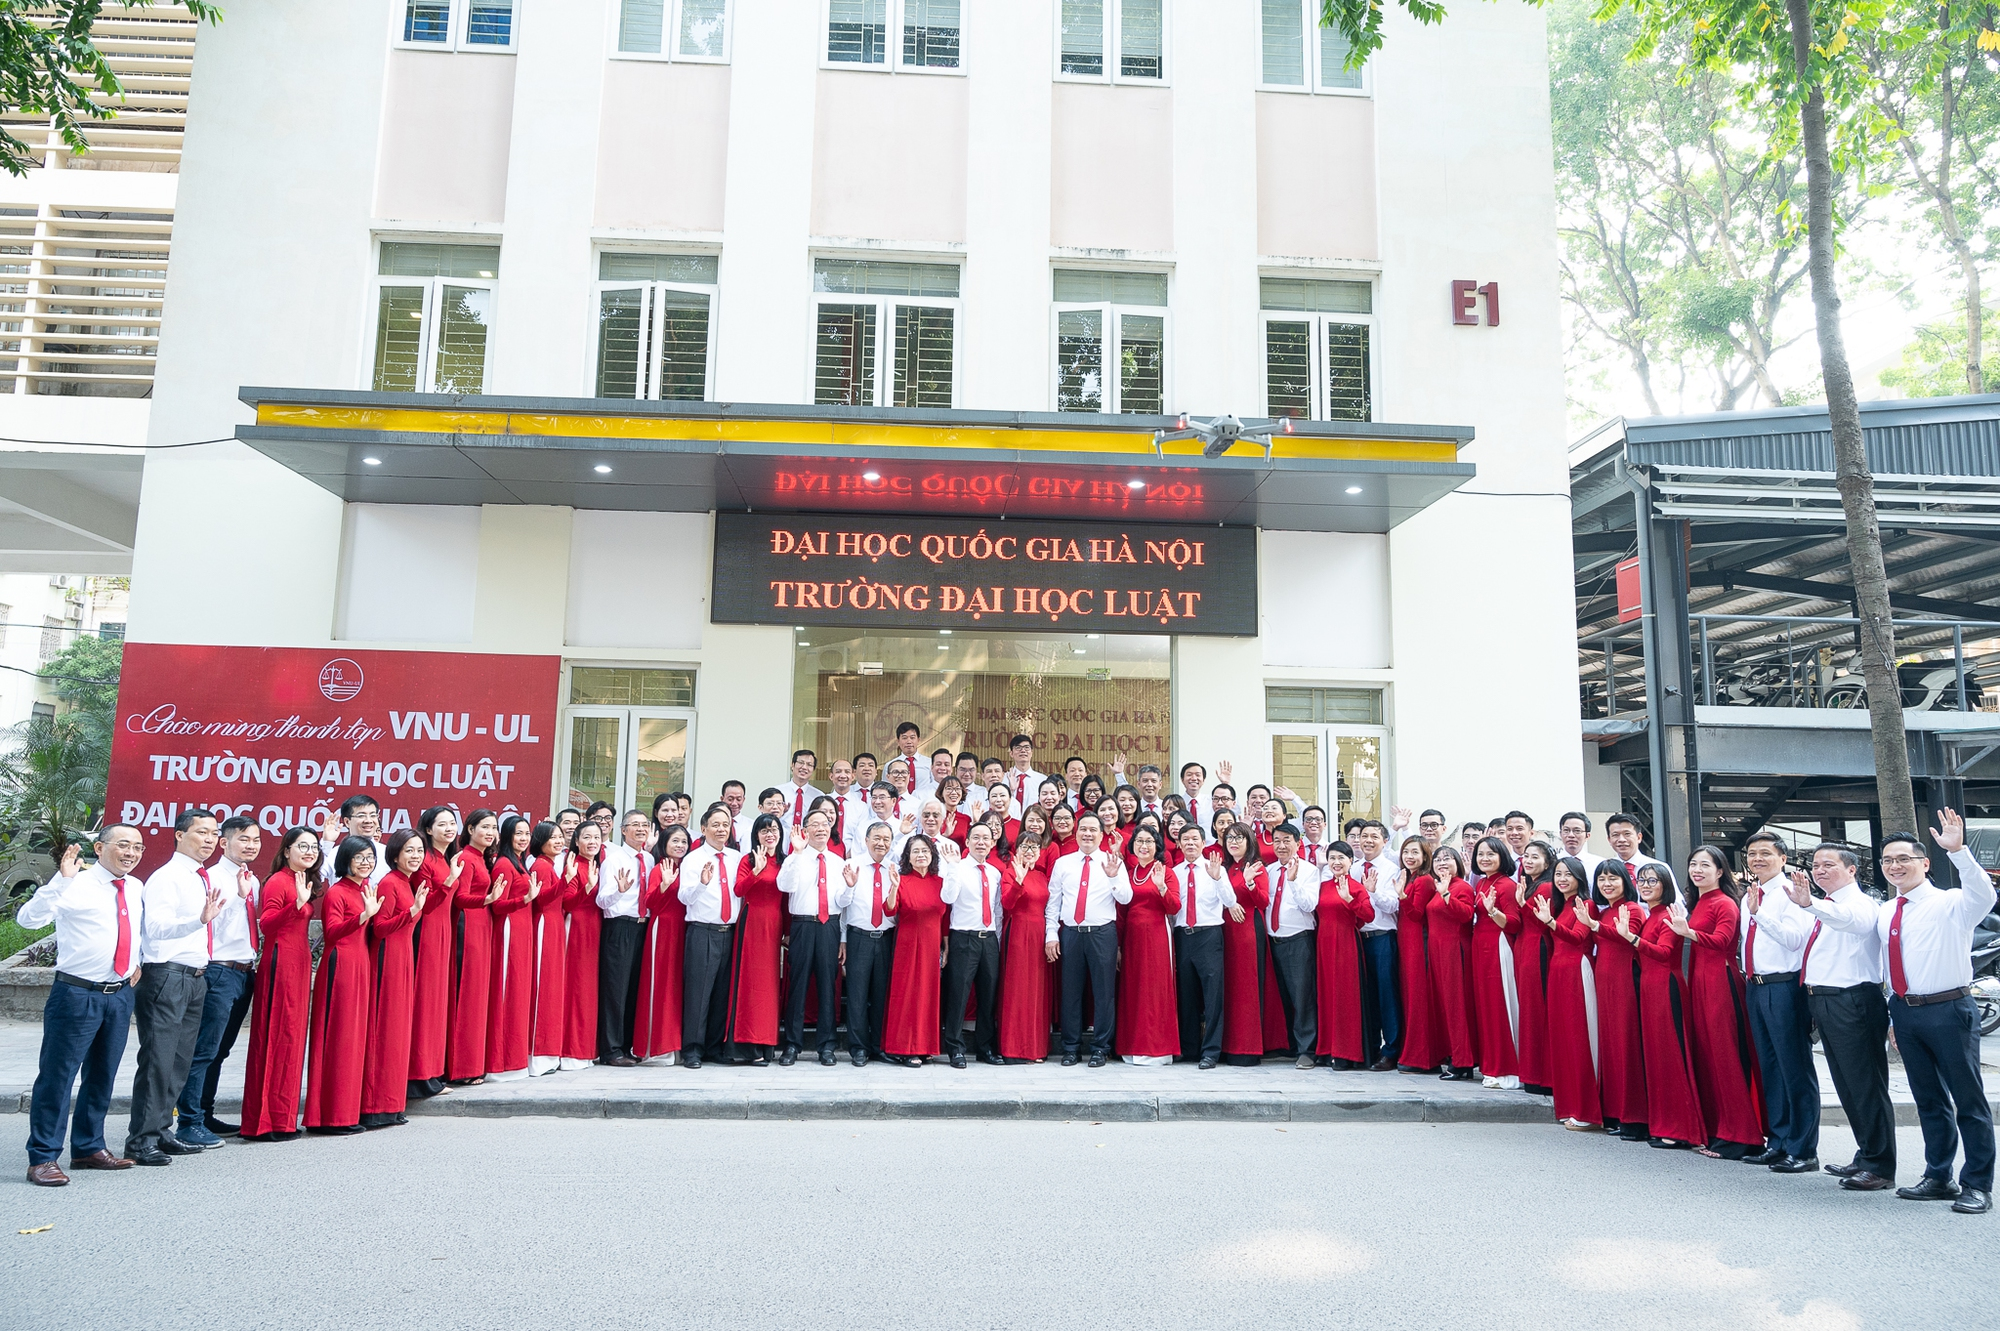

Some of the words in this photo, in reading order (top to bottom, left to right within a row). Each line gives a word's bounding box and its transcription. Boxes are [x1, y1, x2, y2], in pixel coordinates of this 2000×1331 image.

[1451, 279, 1499, 327] E1
[770, 530, 829, 561] ĐẠI
[836, 532, 911, 563] HỌC
[920, 529, 1017, 564] QUỐC
[1025, 537, 1084, 562] GIA
[1088, 533, 1137, 563] HÀ
[1144, 538, 1205, 571] NỘI
[770, 576, 931, 611] TRƯỜNG
[938, 585, 1004, 620] ĐẠI
[1013, 587, 1093, 622] HỌC
[1103, 588, 1201, 625] LUẬT
[126, 703, 204, 735] Chào
[274, 714, 345, 740] thành
[389, 710, 470, 741] VNU
[494, 713, 540, 743] UL
[1049, 704, 1096, 725] QUỐC
[1100, 709, 1130, 724] GIA
[1053, 733, 1095, 755] ĐẠI
[1100, 734, 1149, 755] HỌC
[149, 749, 292, 785] TRƯỜNG
[297, 759, 353, 794] ĐẠI
[358, 761, 428, 795] HỌC
[433, 757, 515, 798] LUẬT
[121, 800, 178, 835] ĐẠI
